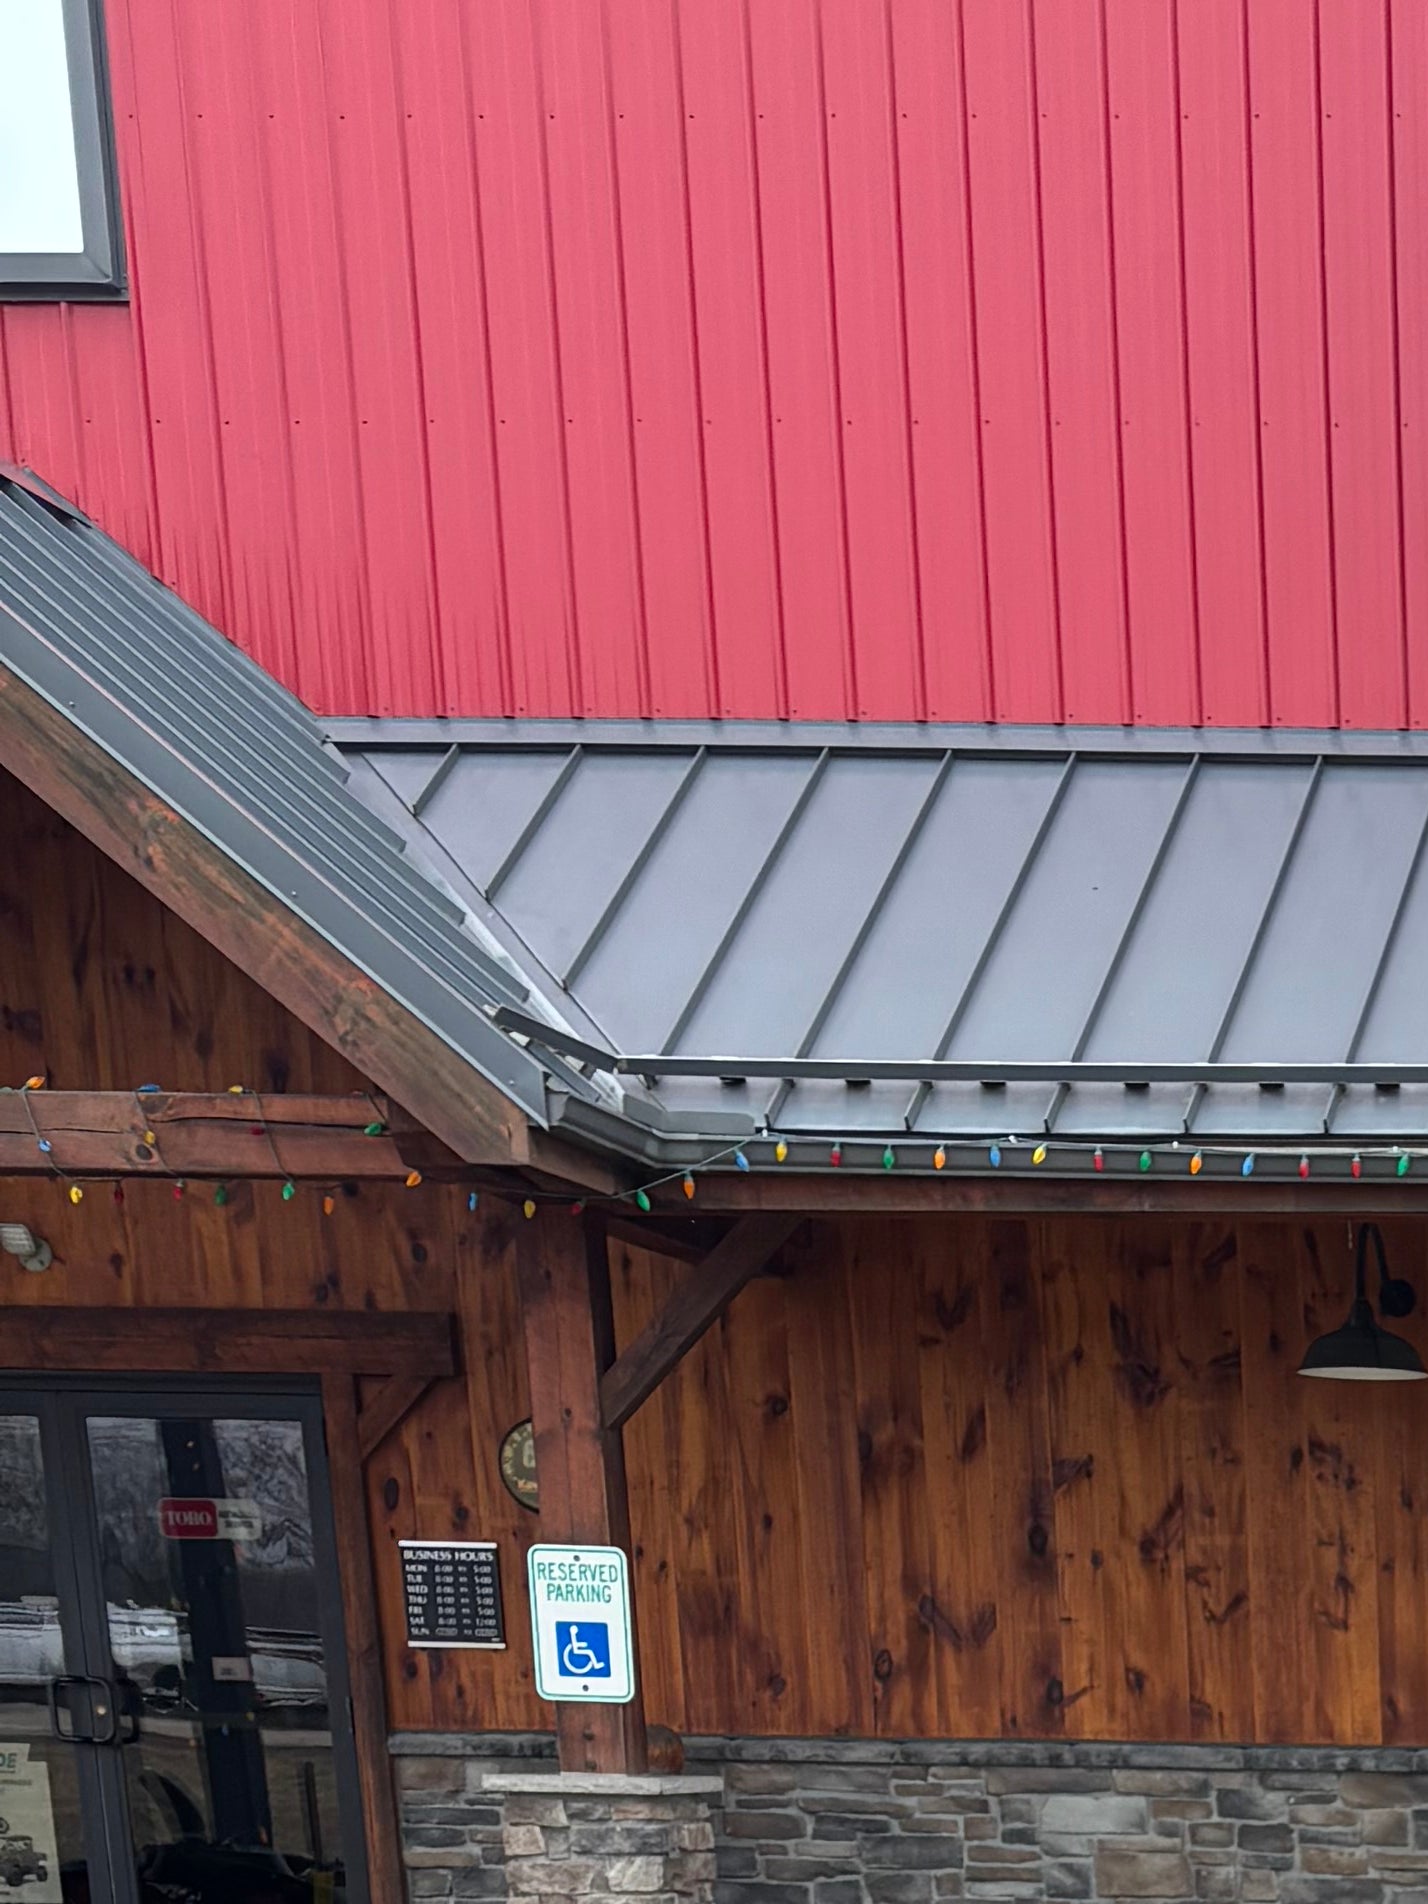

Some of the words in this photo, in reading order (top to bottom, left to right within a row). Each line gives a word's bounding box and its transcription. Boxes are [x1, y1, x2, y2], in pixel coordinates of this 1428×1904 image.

[167, 1510, 212, 1526] TORO
[403, 1550, 452, 1561] BUSINESS
[455, 1551, 494, 1562] HOURS
[536, 1562, 619, 1583] RESERVED
[546, 1583, 612, 1604] PARKING
